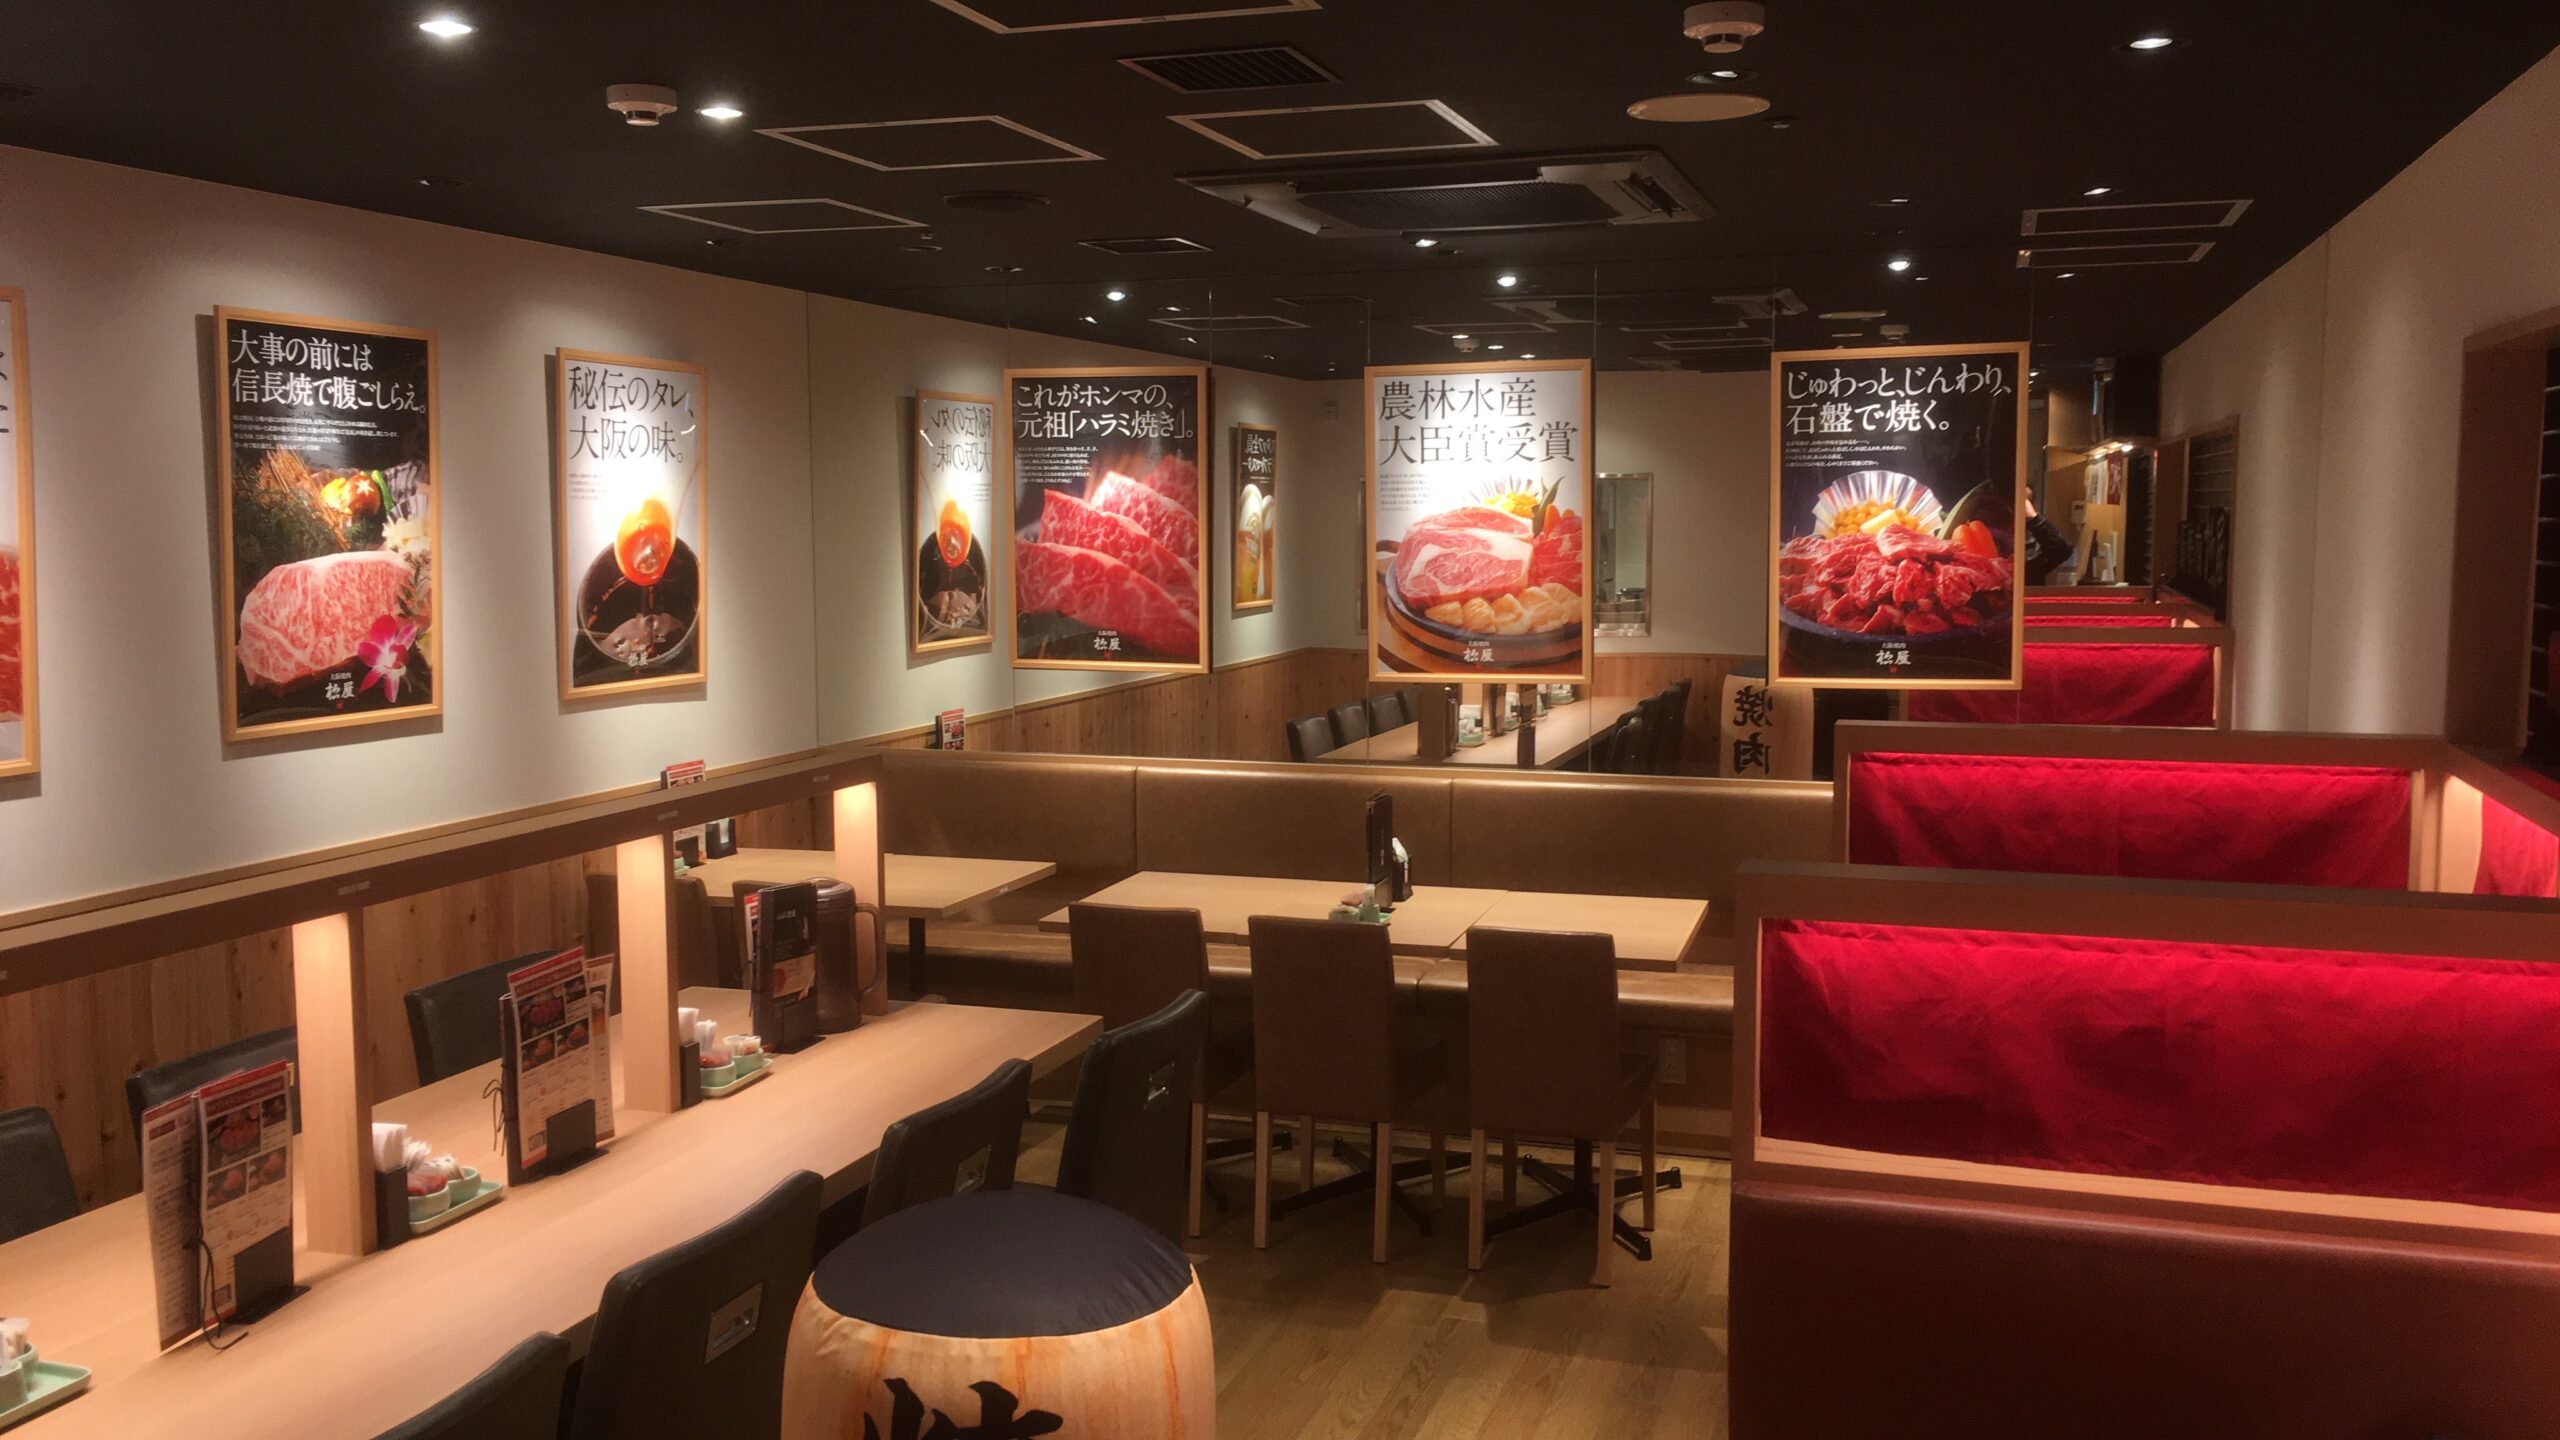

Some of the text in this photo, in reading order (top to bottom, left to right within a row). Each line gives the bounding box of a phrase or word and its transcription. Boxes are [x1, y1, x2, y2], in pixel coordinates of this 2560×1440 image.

[231, 328, 374, 372] 大事の前には
[231, 368, 427, 414] 信長焼で腹ごしらえ。
[568, 366, 695, 419] 秘伝のタレ、
[1016, 383, 1174, 409] これがホンマの、
[1379, 377, 1537, 421] 農林水産
[1787, 363, 2012, 400] じゅわっと、じんわり、
[1018, 408, 1194, 439] 元祖「ハラミ焼き」。
[1785, 399, 1950, 435] 石盤で焼く。
[569, 415, 684, 464] 大阪の味。
[1379, 421, 1579, 466] 大臣賞受賞
[1875, 649, 1912, 665] 松屋
